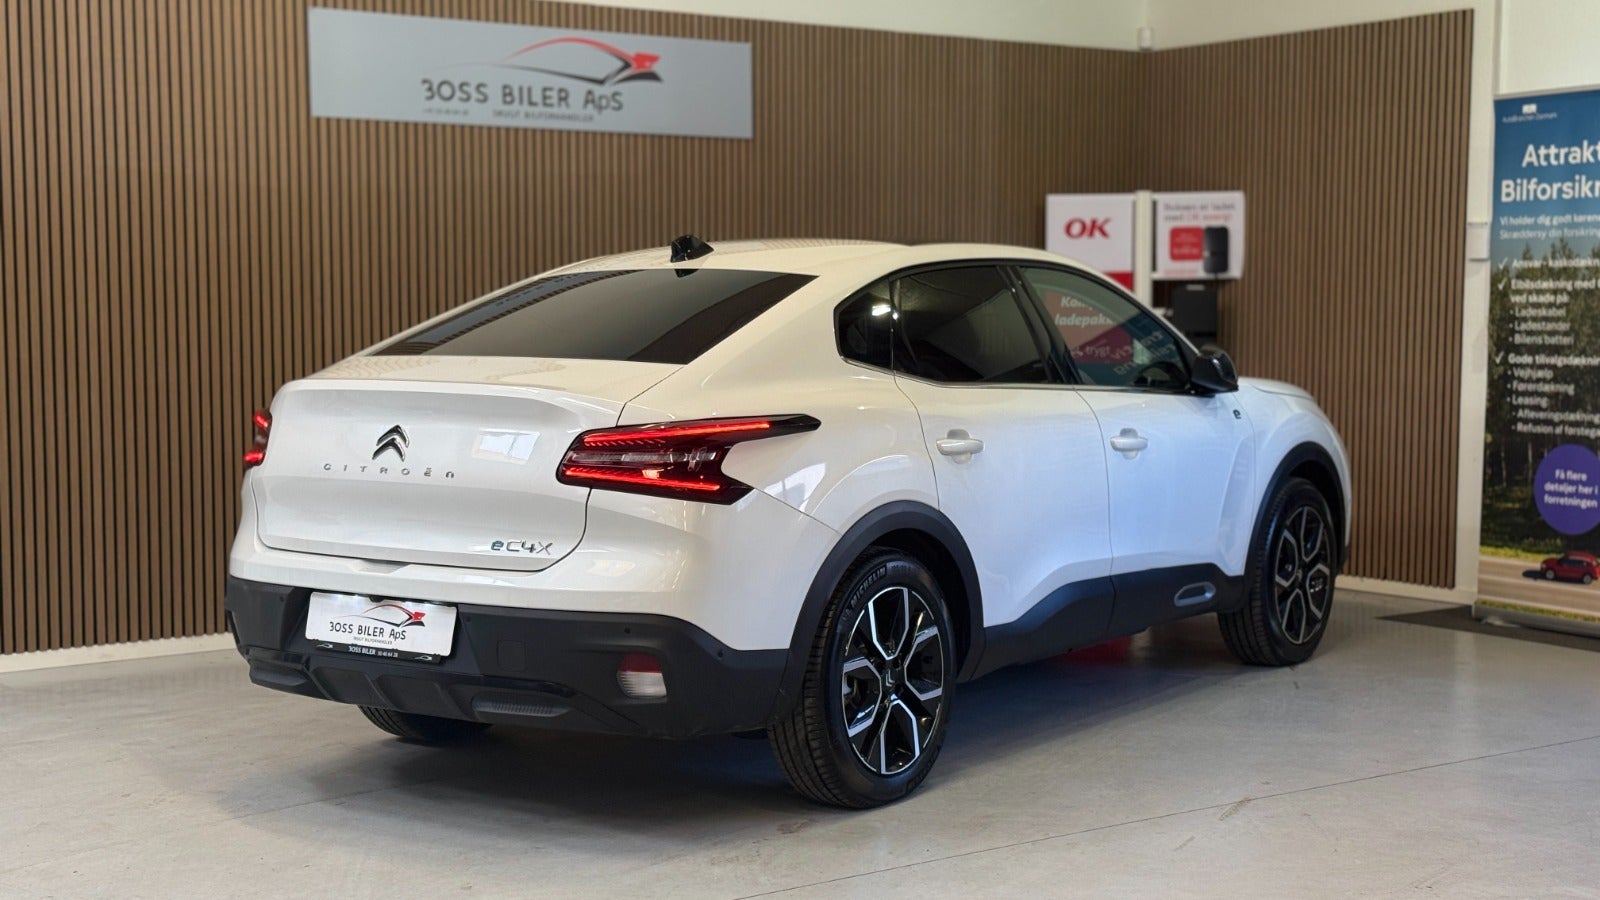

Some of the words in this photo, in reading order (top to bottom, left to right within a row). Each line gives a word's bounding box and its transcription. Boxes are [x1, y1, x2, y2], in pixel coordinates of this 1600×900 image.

[502, 85, 570, 108] BILER
[582, 90, 624, 114] ApS
[1065, 218, 1110, 239] OK
[850, 566, 887, 607] MICHELIN
[357, 625, 384, 638] BILER
[389, 628, 406, 641] ApS
[362, 647, 376, 656] BILER
